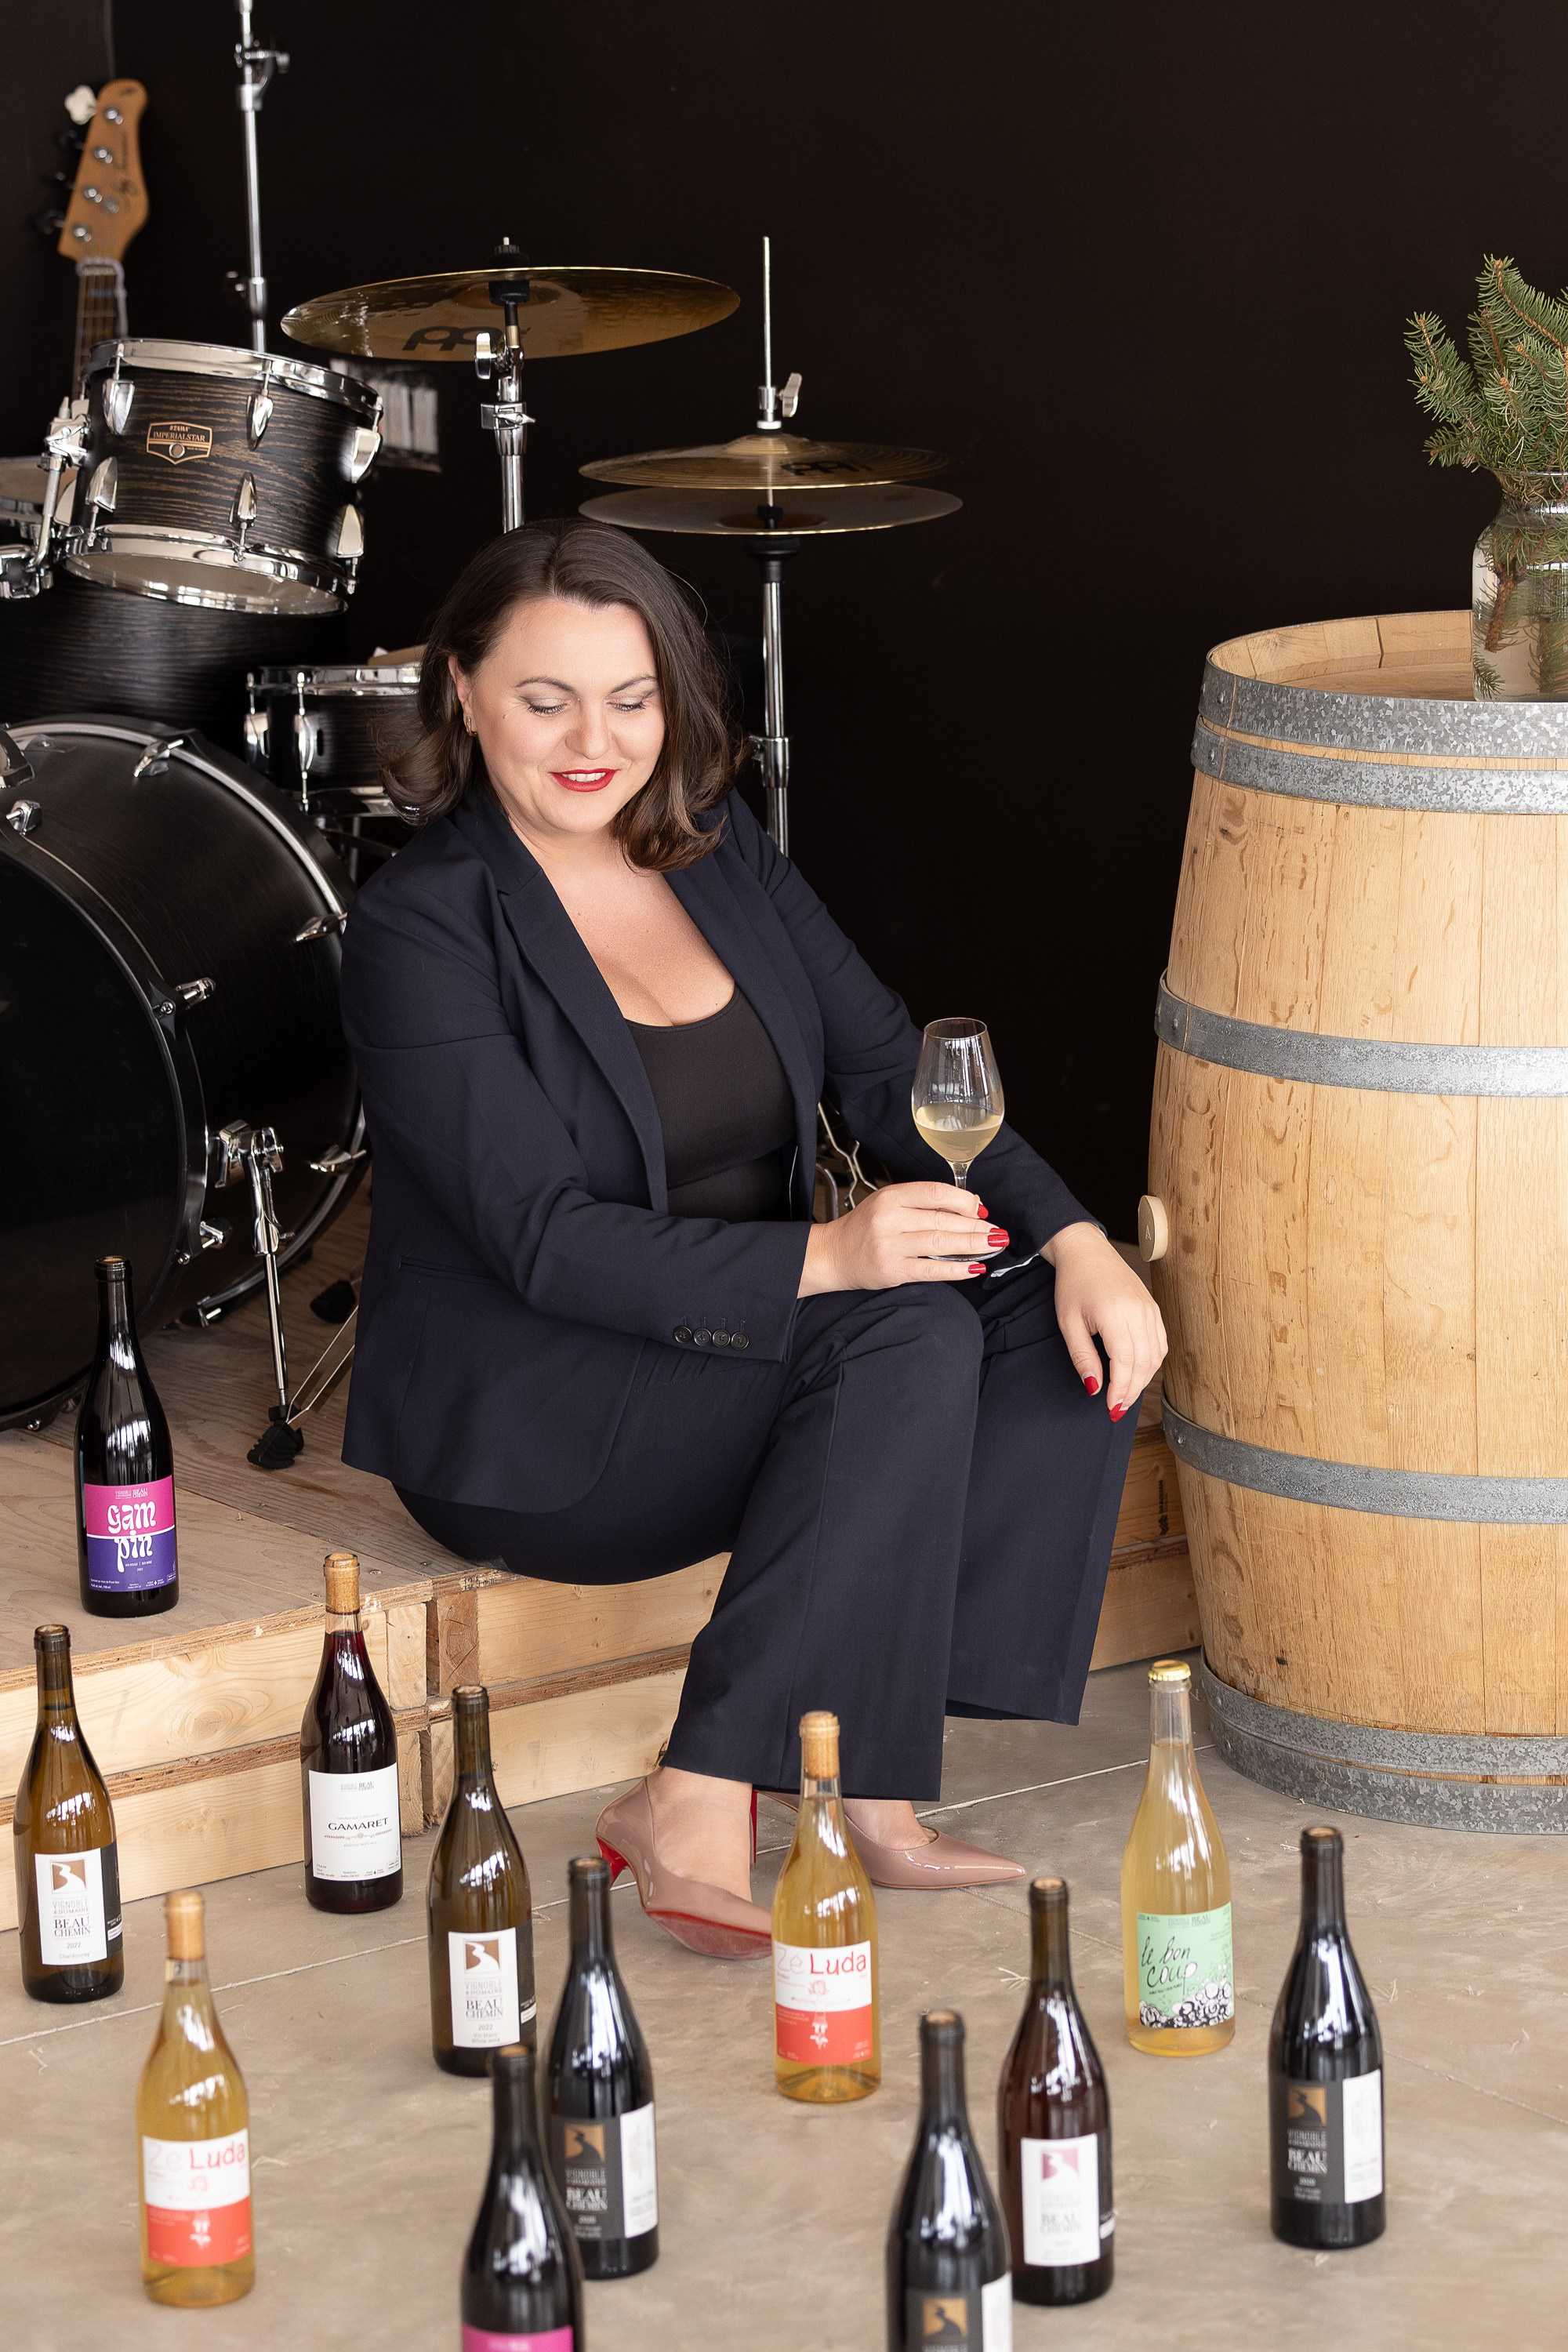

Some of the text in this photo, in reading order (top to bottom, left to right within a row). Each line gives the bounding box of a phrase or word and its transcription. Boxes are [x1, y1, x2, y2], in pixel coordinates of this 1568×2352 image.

[153, 430, 205, 442] IMPERIALSTAR
[107, 1501, 157, 1534] gam
[114, 1530, 154, 1573] pin
[328, 1817, 389, 1831] GAMARET
[53, 1898, 89, 1910] VIGNOBLE
[58, 1907, 89, 1915] DOMAINE
[54, 1916, 90, 1929] BEAU
[54, 1926, 91, 1938] CHEMIN
[1141, 1936, 1190, 1968] le bon
[810, 1951, 866, 1976] Luda
[464, 1980, 502, 1991] VIGNOBLE
[1146, 1962, 1198, 1995] coup
[466, 1998, 503, 2010] BEAU
[466, 2009, 503, 2019] CHEMIN
[190, 2140, 246, 2170] Luda
[1288, 2147, 1327, 2163] BEAU
[566, 2187, 608, 2201] BEAU
